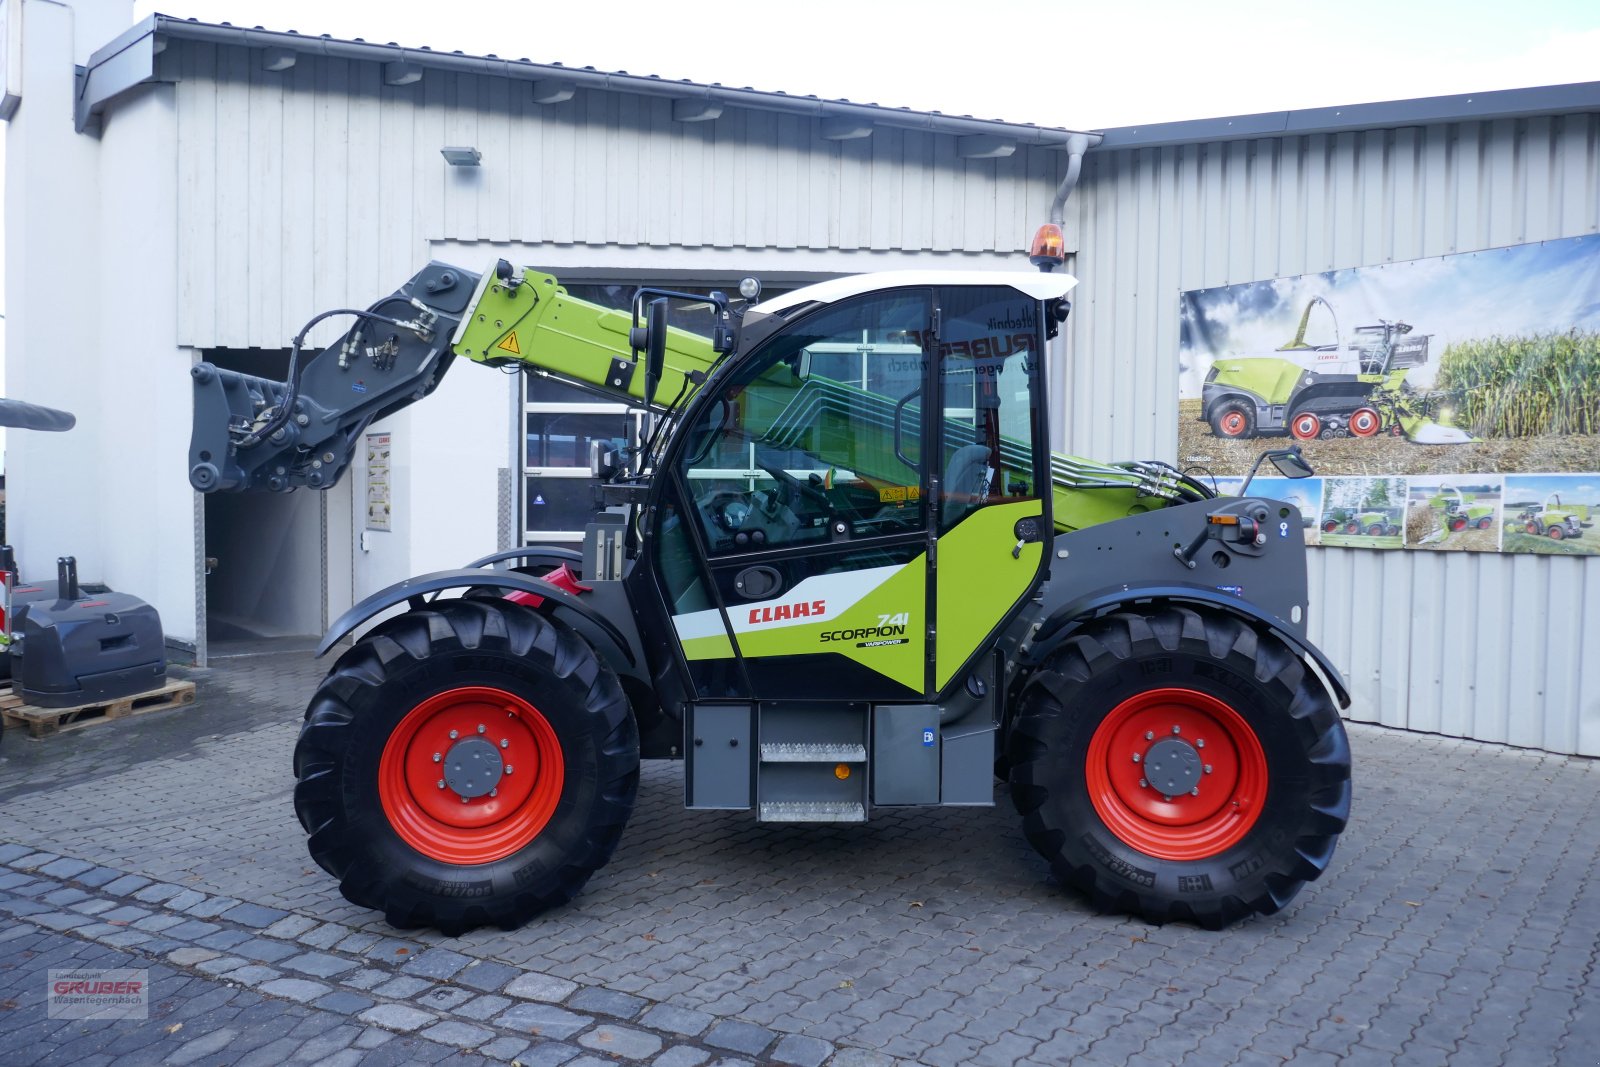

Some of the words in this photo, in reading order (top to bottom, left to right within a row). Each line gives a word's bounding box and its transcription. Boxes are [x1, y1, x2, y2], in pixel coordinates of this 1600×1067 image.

[749, 600, 826, 624] CLAAS
[877, 612, 909, 627] 741
[820, 625, 905, 642] SCORPION
[865, 639, 902, 647] VARIPOWER
